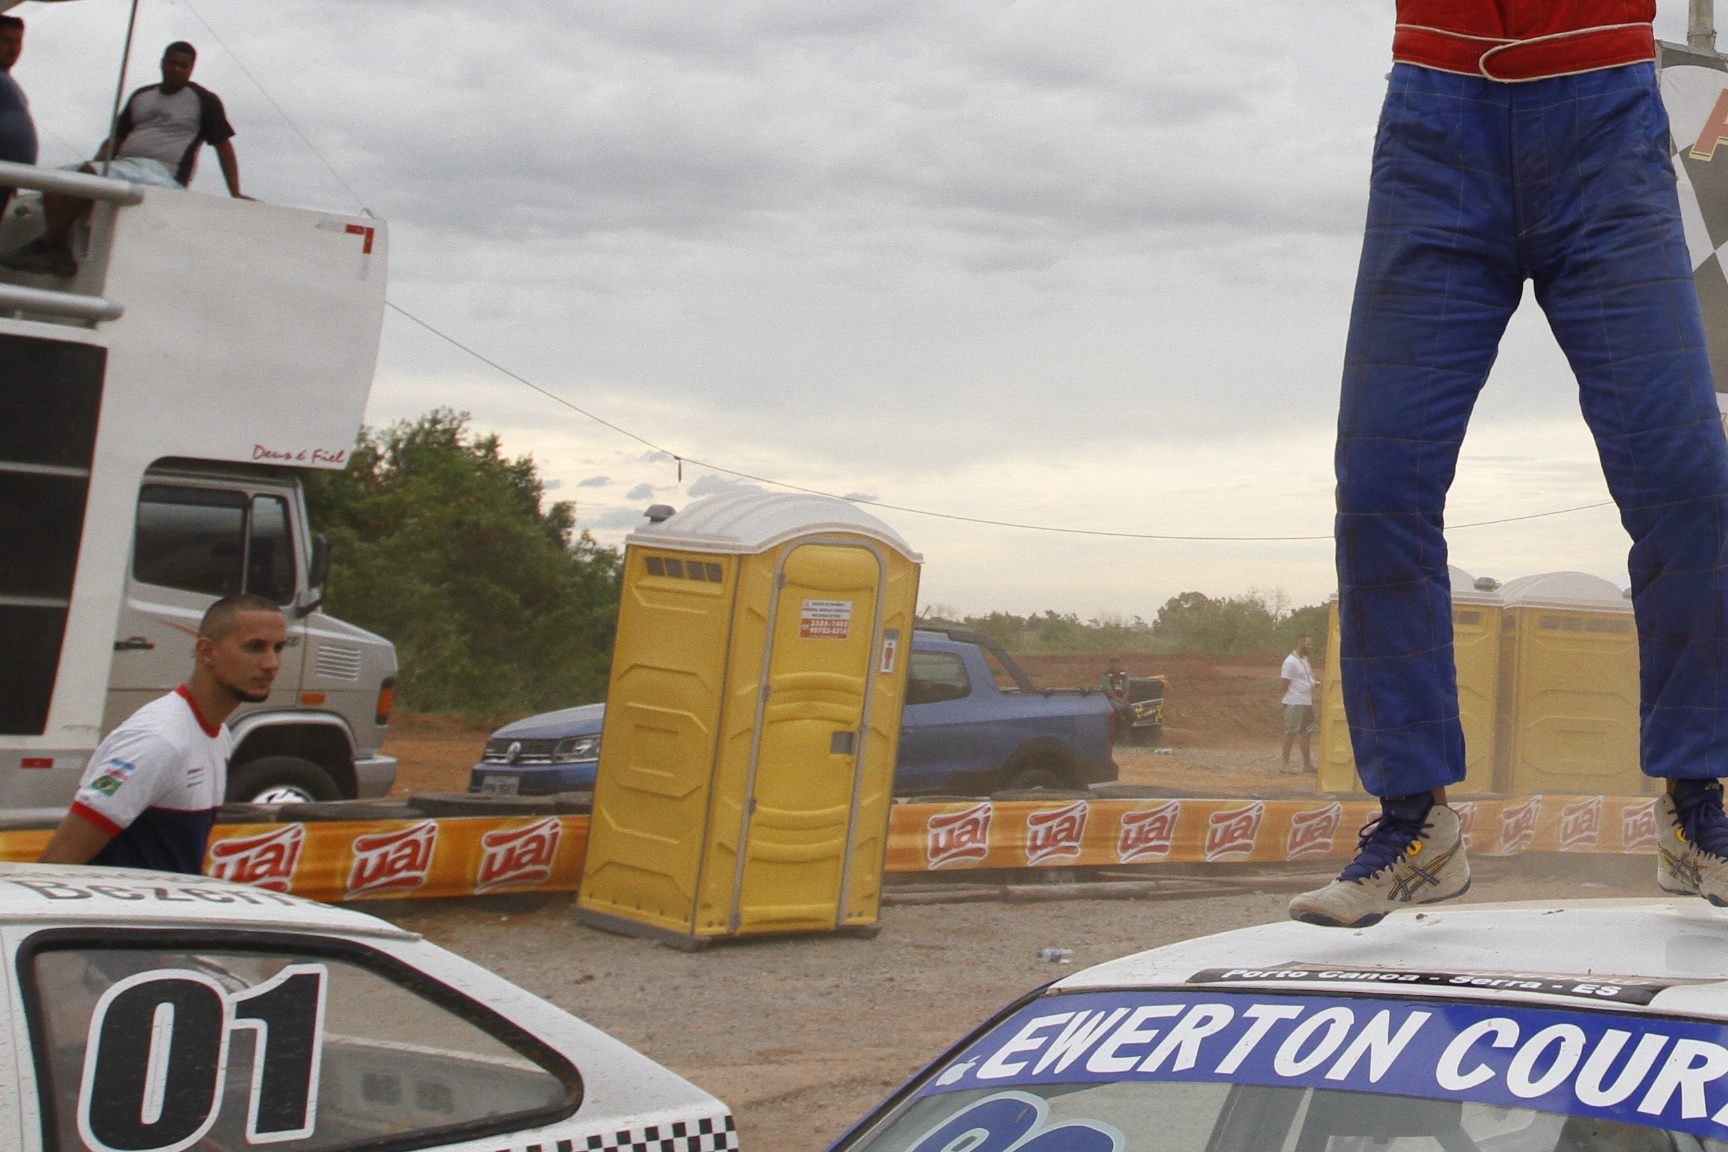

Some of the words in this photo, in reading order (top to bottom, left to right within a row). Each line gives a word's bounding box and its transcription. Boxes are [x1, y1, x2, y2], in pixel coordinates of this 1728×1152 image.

[252, 444, 292, 460] Deus
[312, 448, 345, 465] Fiel
[1221, 969, 1309, 979] Porto
[1318, 970, 1420, 981] Canoa
[1449, 974, 1542, 989] Serra
[1571, 983, 1622, 996] ES
[77, 964, 328, 1152] 01
[976, 1003, 1432, 1084] EWERTON
